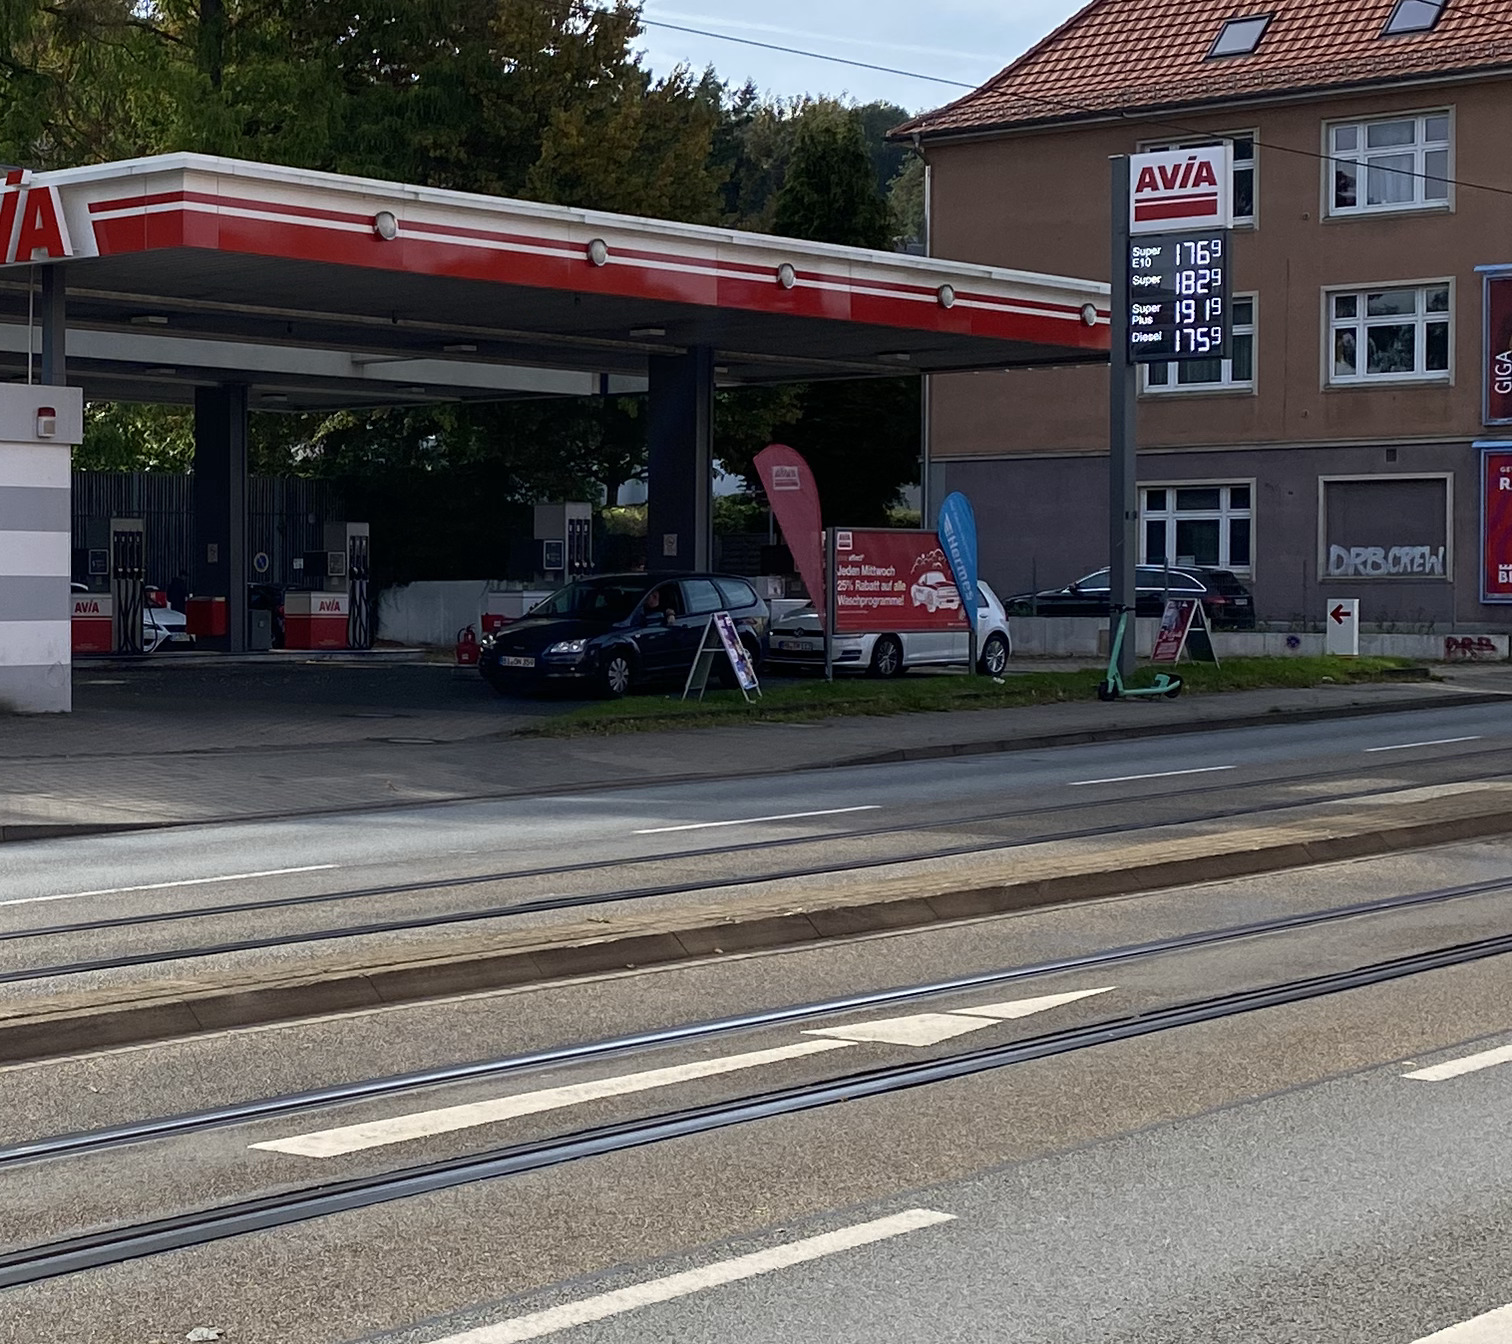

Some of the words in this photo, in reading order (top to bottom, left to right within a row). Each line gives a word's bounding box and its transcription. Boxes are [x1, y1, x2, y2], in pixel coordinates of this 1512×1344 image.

[1132, 246, 1162, 258] Super
[1132, 257, 1152, 268] E10
[1132, 274, 1162, 286] Super
[1132, 302, 1162, 315] Super
[1131, 315, 1154, 326] Plus
[1131, 330, 1163, 343] Diesel
[837, 565, 860, 576] Jeden
[861, 565, 896, 576] Mittwoch
[948, 534, 974, 601] Hermes
[837, 580, 854, 591] 25%
[855, 580, 880, 591] Rabatt
[881, 580, 893, 591] auf
